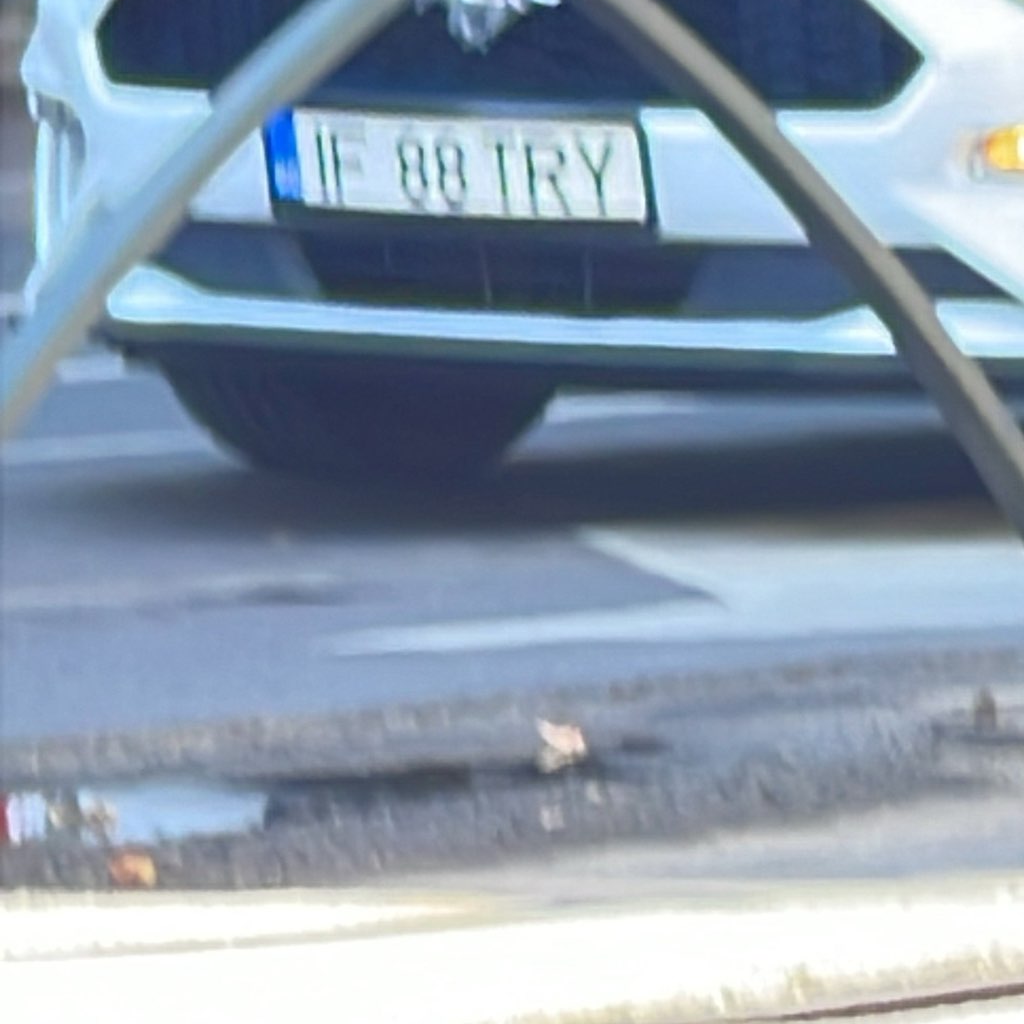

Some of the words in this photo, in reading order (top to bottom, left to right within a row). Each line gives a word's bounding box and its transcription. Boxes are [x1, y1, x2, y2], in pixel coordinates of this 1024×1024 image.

[314, 123, 366, 205] IF
[396, 125, 467, 213] 88
[482, 126, 613, 217] TRY
